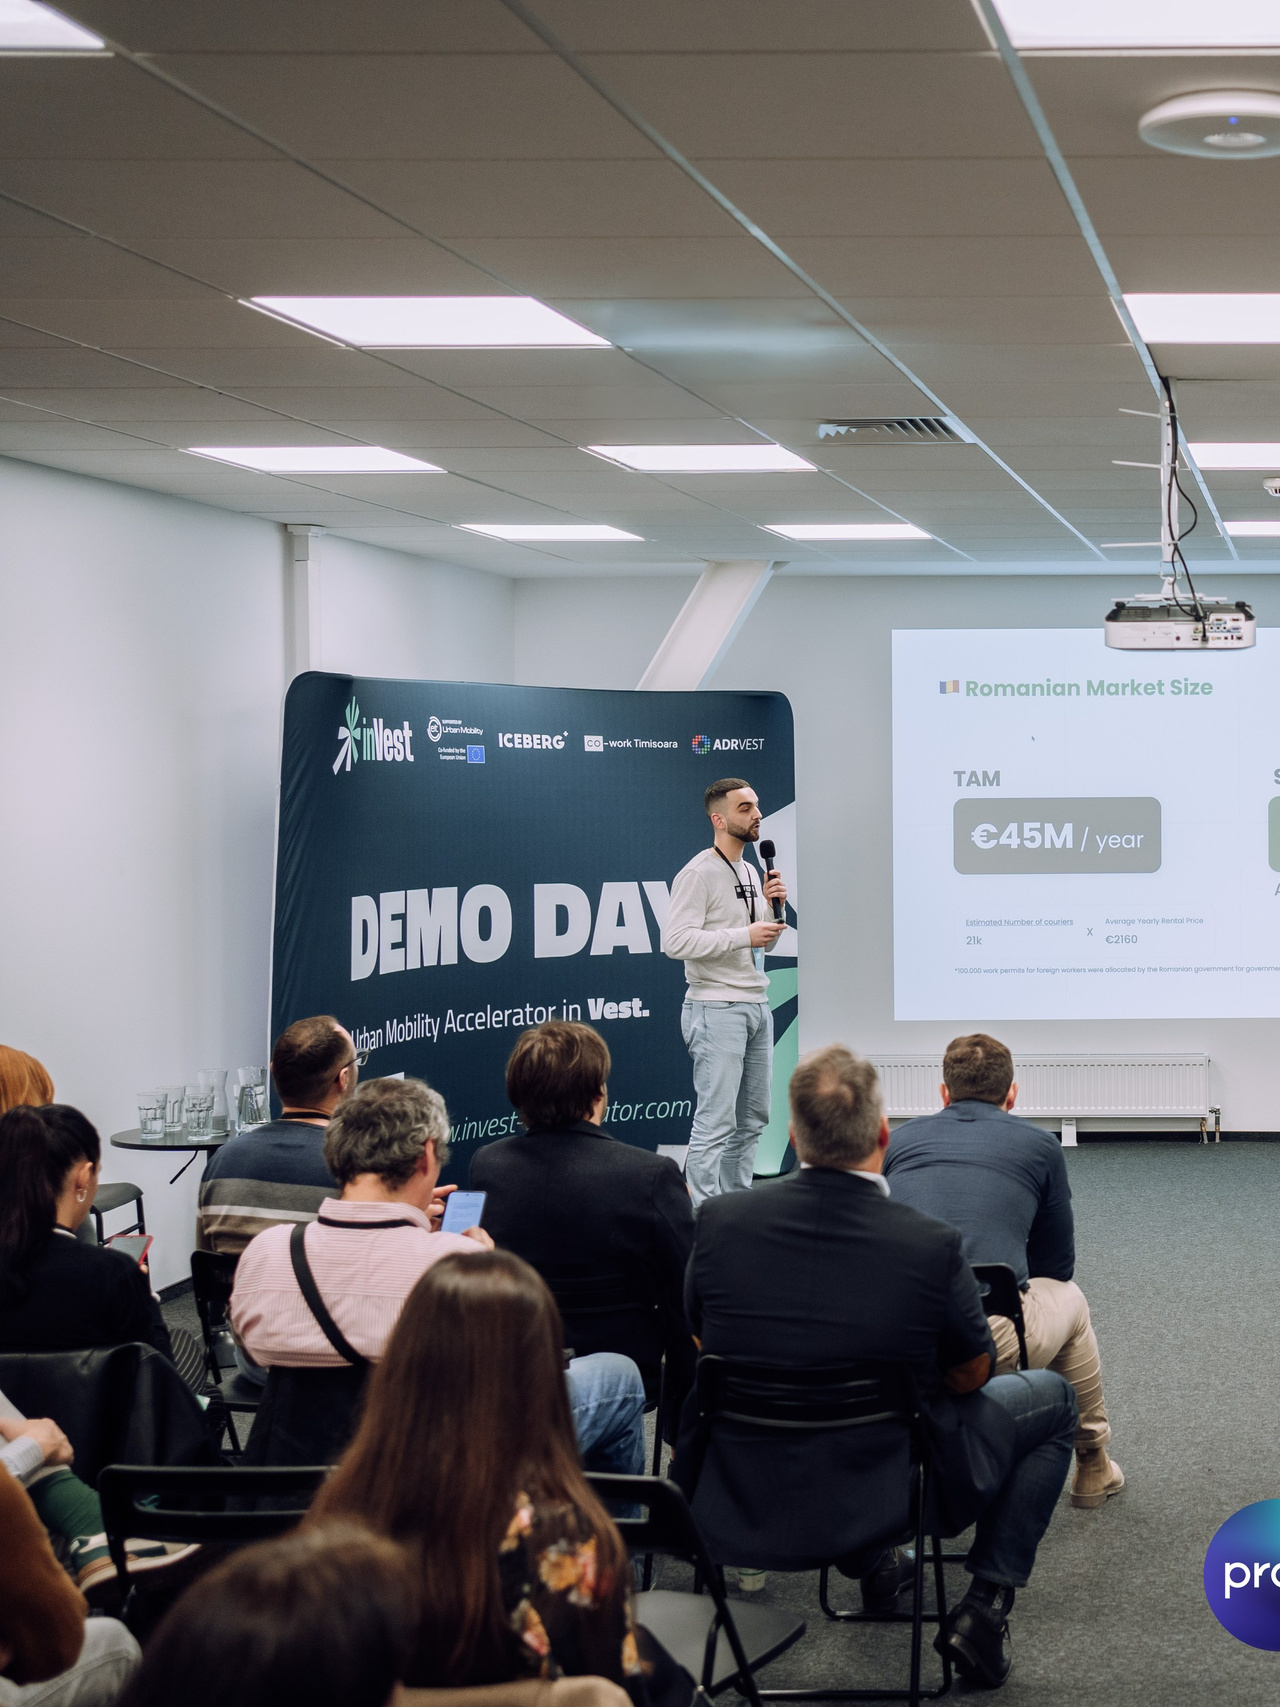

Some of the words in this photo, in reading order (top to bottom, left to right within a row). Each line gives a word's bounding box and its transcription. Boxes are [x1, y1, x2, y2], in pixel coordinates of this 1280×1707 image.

[965, 678, 1081, 697] Romanian
[1086, 679, 1165, 696] Market
[1170, 677, 1214, 696] Size
[442, 726, 460, 734] Urban
[460, 726, 484, 736] Mobility
[362, 717, 415, 762] inVest
[634, 738, 678, 749] Timisoara
[713, 738, 765, 750] ADRVEST
[953, 770, 1001, 787] TAM
[971, 822, 1073, 850] €45M
[1080, 826, 1089, 852] /
[1095, 834, 1144, 854] year
[965, 918, 1003, 926] Estimated
[1004, 918, 1033, 926] Number
[1034, 918, 1043, 926] of
[1043, 918, 1074, 926] couriers
[1105, 918, 1136, 926] Average
[1137, 917, 1160, 925] Yearly
[1161, 917, 1185, 925] Rental
[351, 883, 513, 982] DEMO
[966, 935, 982, 945] 21k
[1105, 934, 1138, 944] €2160
[999, 966, 1026, 975] permits
[1036, 966, 1060, 975] foreign
[1061, 966, 1086, 974] workers
[1137, 966, 1146, 974] by
[1194, 965, 1234, 974] government
[351, 1025, 383, 1051] Urban
[386, 1012, 441, 1046] Mobility
[444, 1004, 557, 1035] Accelerator
[562, 999, 582, 1022] in
[587, 997, 650, 1020] Vest.
